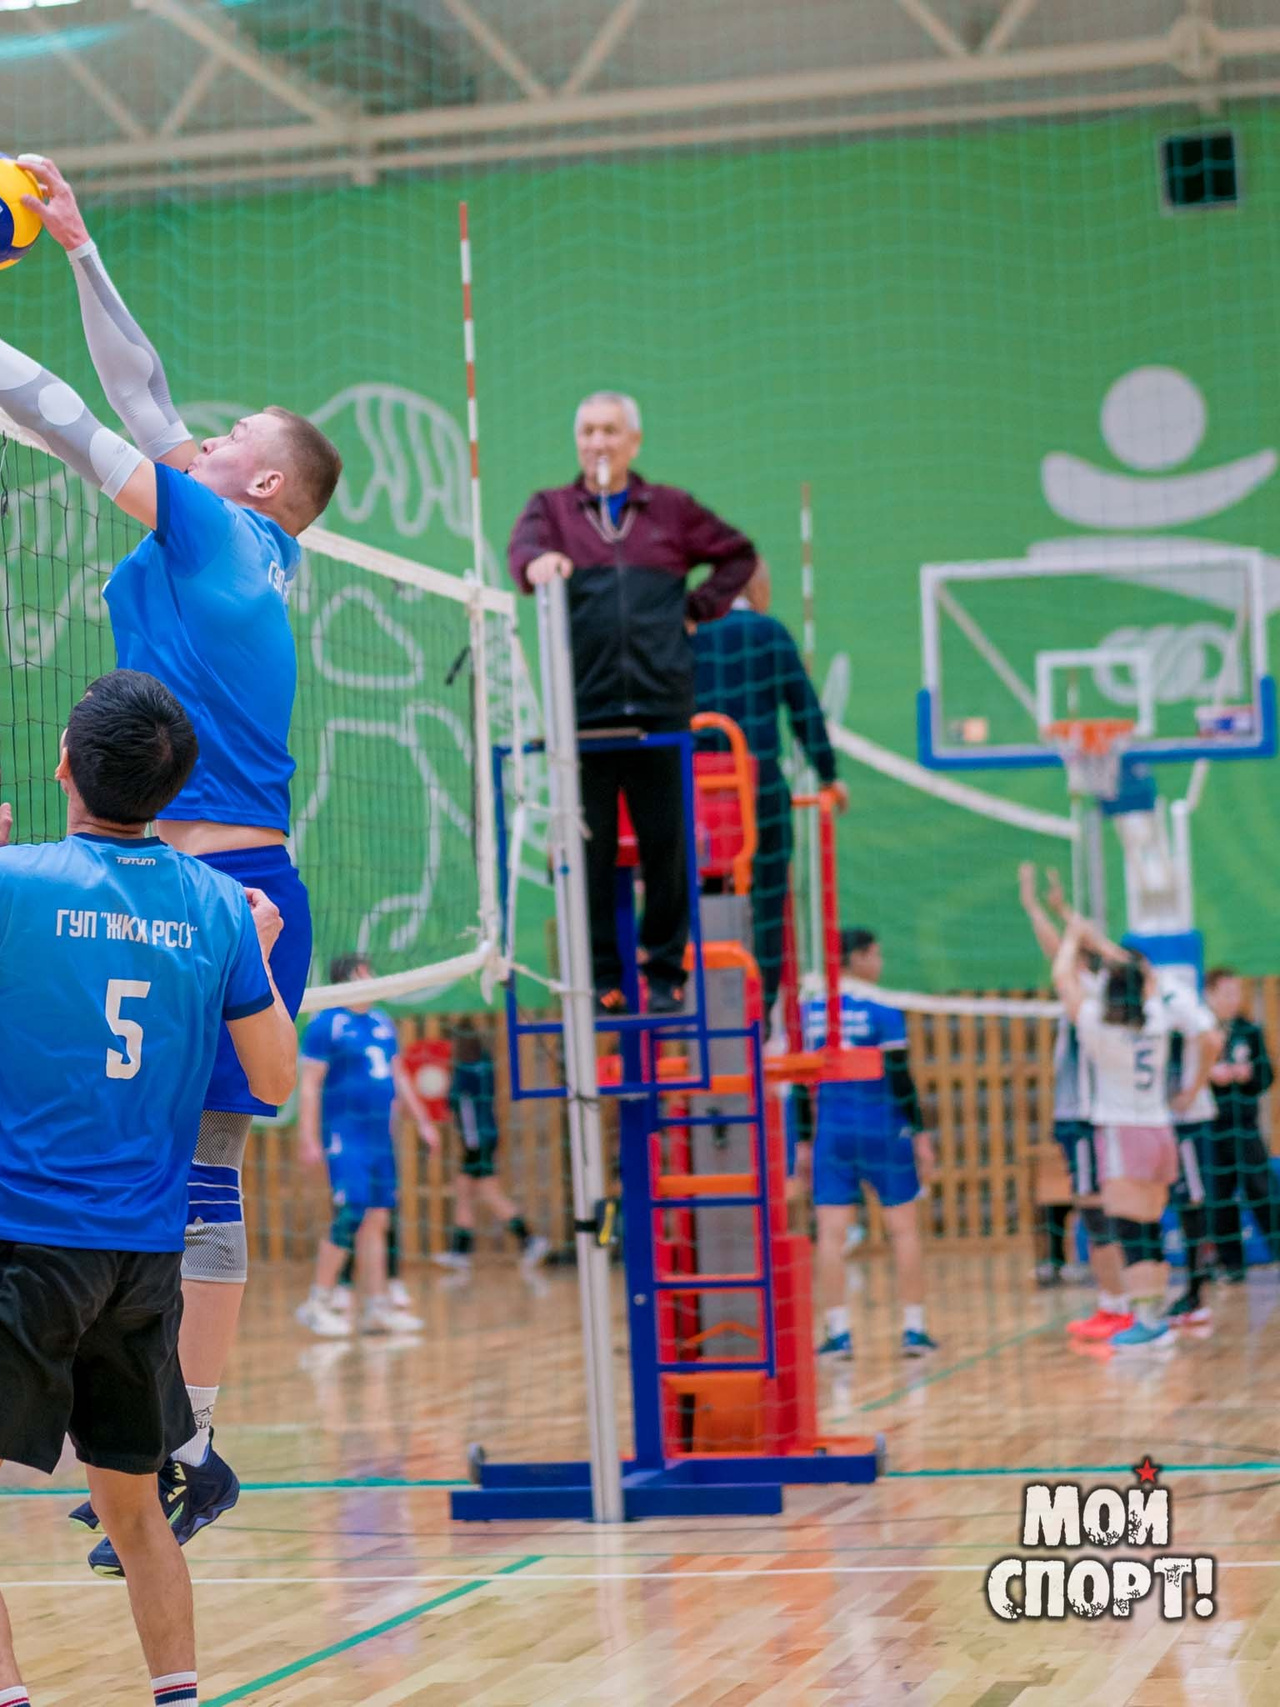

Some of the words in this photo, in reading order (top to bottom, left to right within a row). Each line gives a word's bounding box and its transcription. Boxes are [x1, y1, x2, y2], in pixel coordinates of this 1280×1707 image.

[56, 909, 97, 938] ГУП
[105, 978, 151, 1080] 5
[1134, 1049, 1155, 1092] 5
